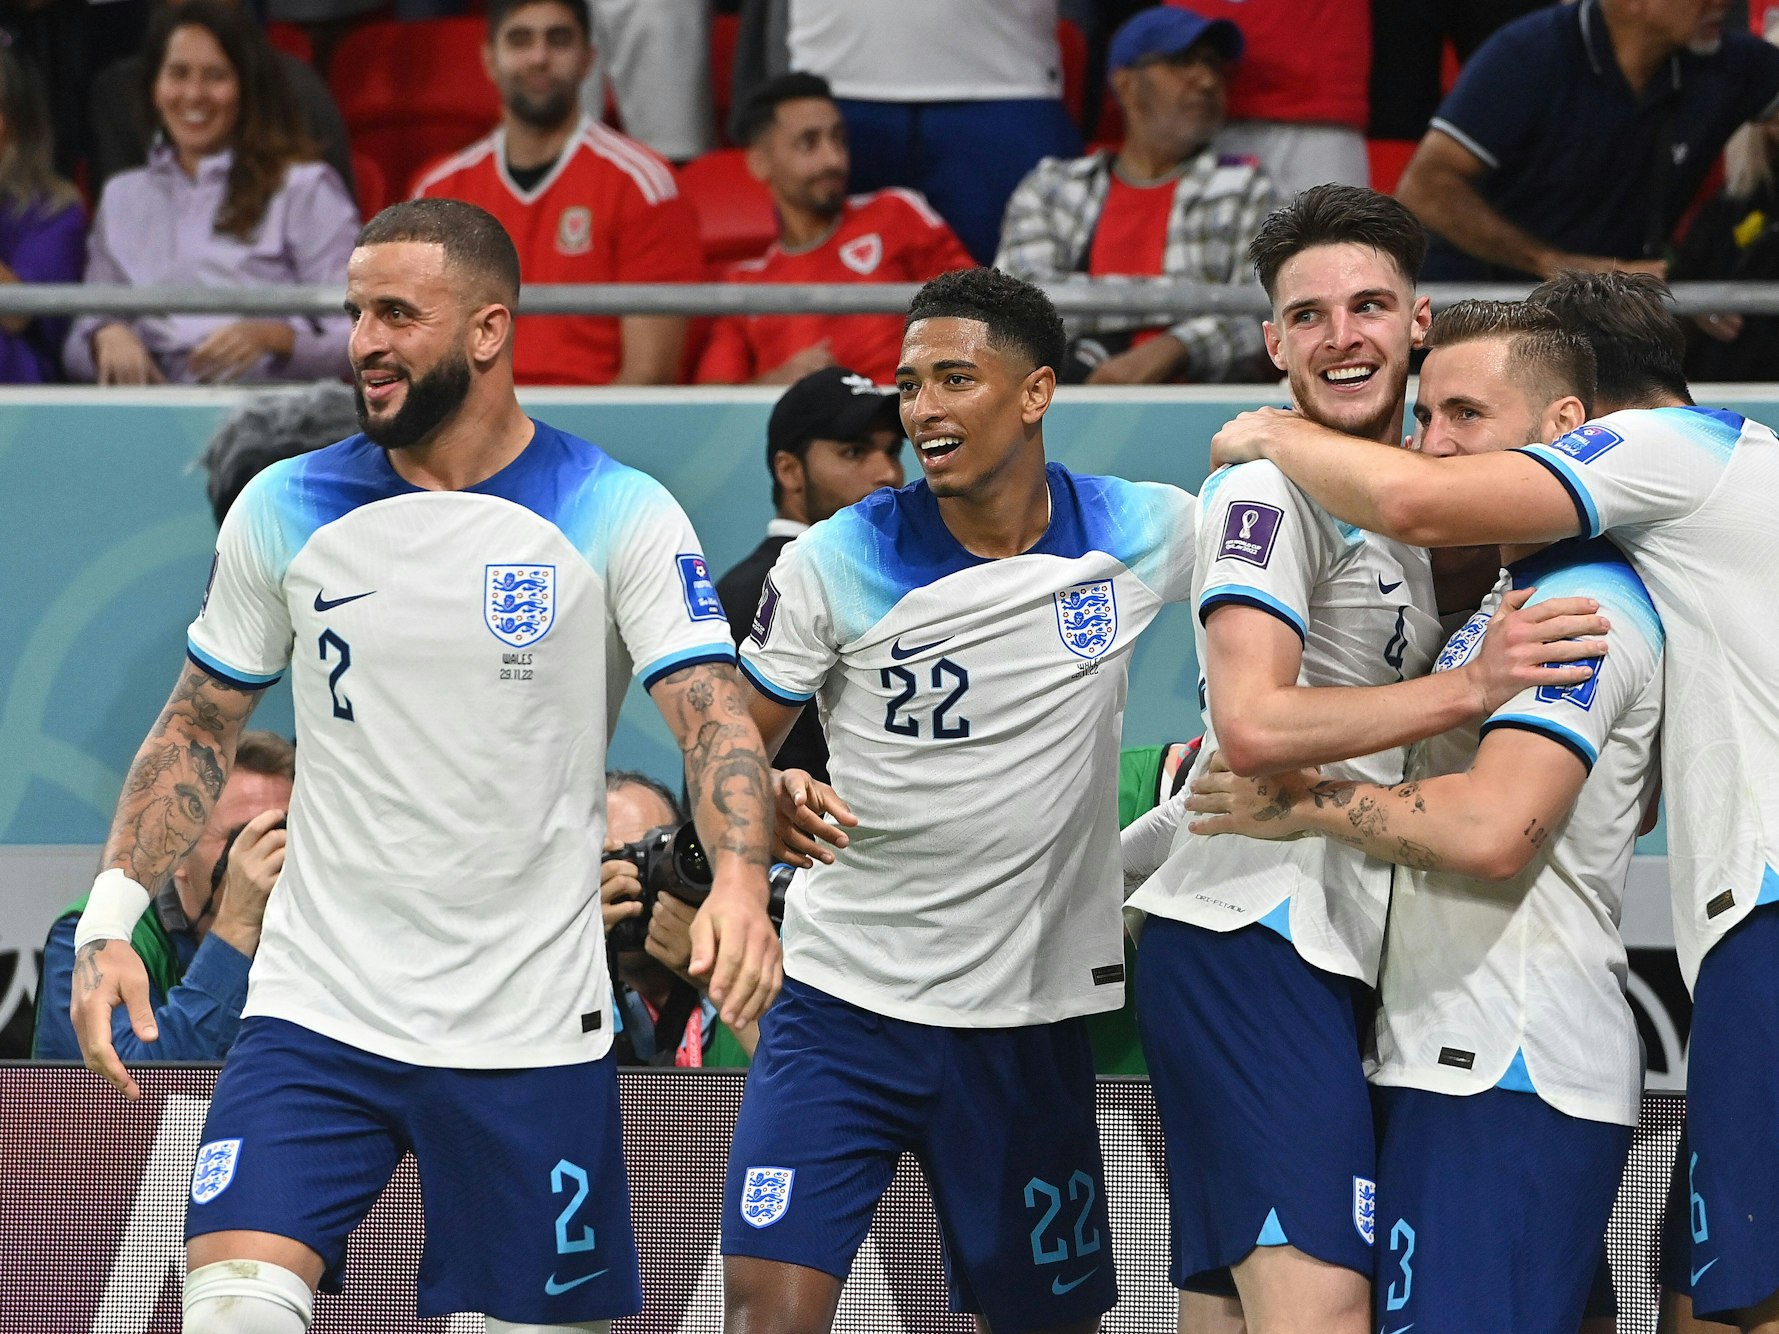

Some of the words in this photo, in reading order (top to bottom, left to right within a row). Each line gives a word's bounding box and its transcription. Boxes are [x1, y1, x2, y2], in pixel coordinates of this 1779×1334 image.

[318, 627, 355, 722] 2
[500, 668, 534, 680] 29.11.22
[502, 653, 533, 665] WALES
[880, 657, 970, 739] 22
[550, 1158, 596, 1255] 2
[1024, 1168, 1101, 1265] 22
[1689, 1151, 1709, 1244] 6
[1386, 1217, 1416, 1311] 3
